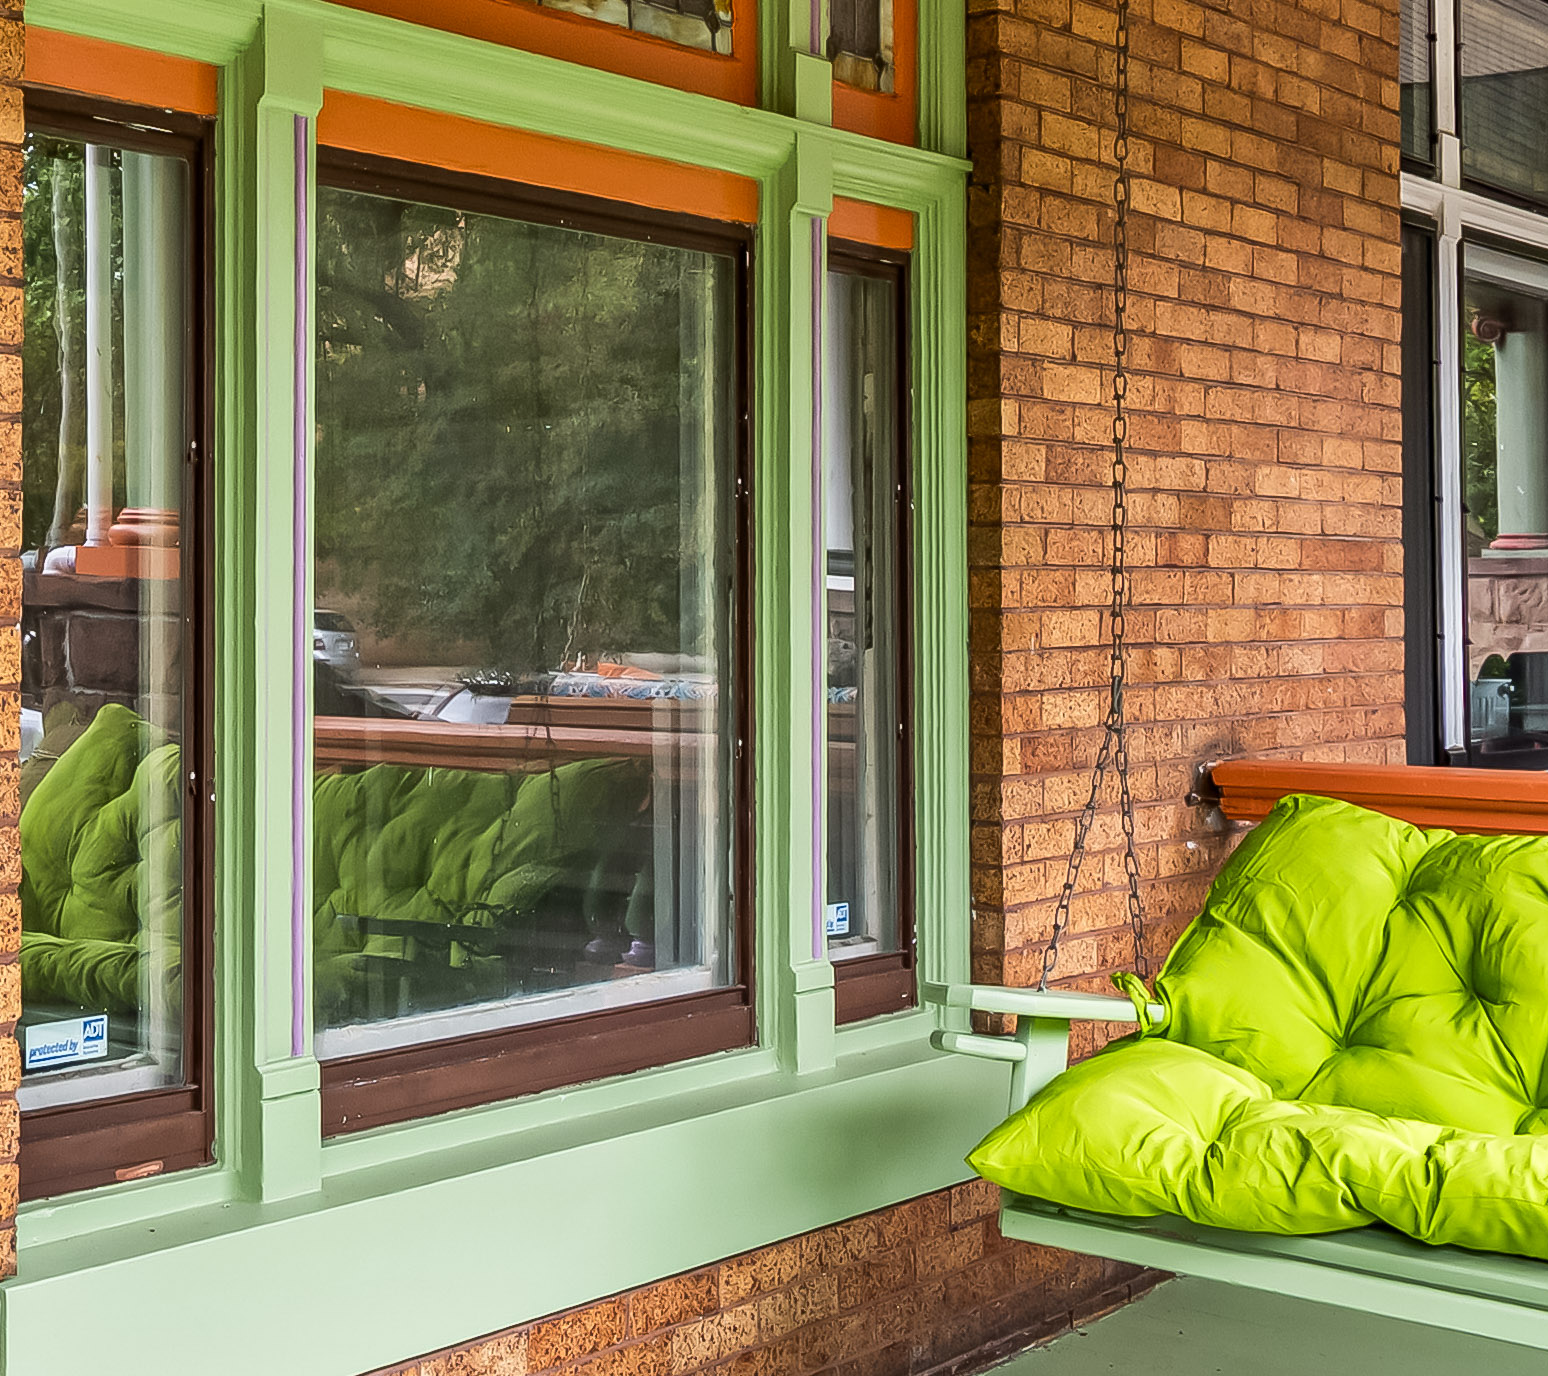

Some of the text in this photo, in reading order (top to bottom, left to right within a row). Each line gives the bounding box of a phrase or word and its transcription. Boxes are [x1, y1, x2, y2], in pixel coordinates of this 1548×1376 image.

[84, 1021, 104, 1039] ADT
[29, 1040, 69, 1059] protected
[69, 1039, 79, 1052] by
